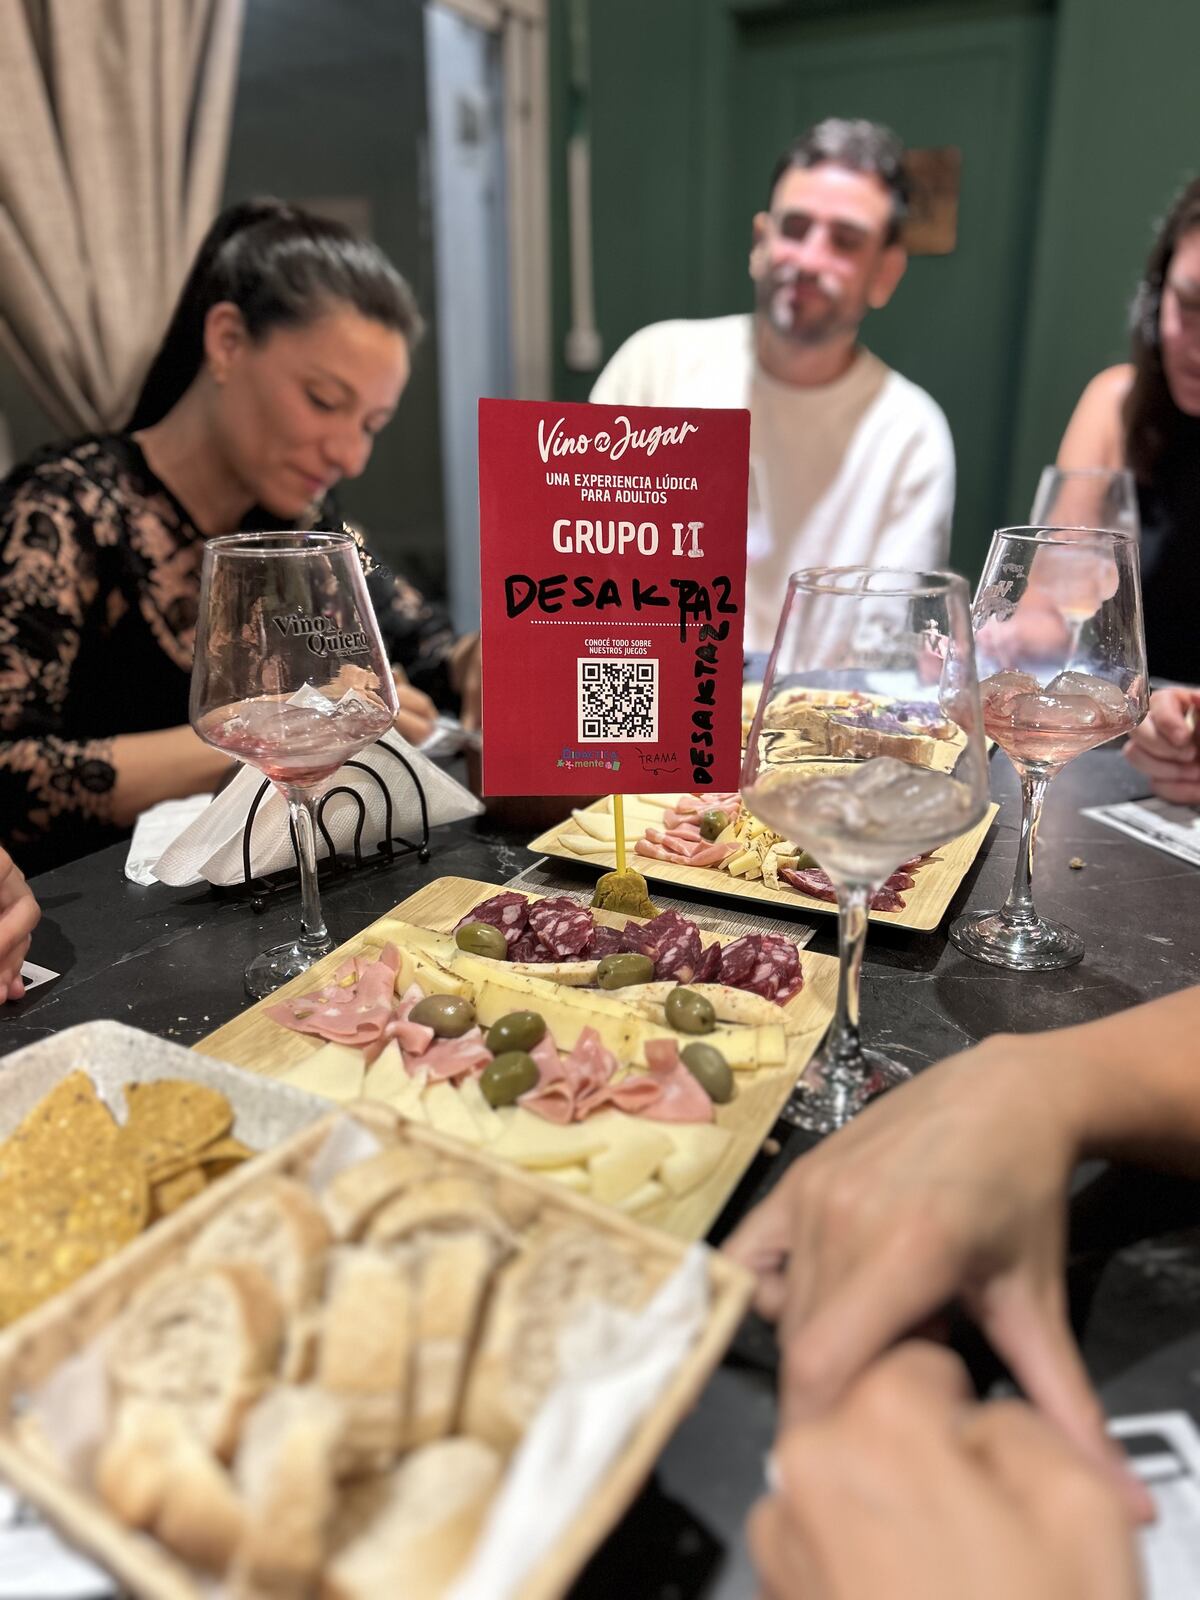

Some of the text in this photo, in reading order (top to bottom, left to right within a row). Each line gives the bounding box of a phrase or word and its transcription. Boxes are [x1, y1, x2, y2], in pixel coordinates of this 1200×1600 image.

[537, 417, 592, 463] Vino
[609, 415, 699, 461] Jugar
[546, 472, 698, 490] UNA EXPERIENCIA LÚDICA
[581, 489, 668, 504] PARA ADULTOS
[552, 519, 659, 556] GRUPO
[272, 614, 326, 637] Vino
[306, 629, 369, 657] Quiero
[584, 637, 652, 647] CONOCÉ TODO SOBRE
[589, 647, 648, 656] NUESTROS JUEGOS
[574, 759, 604, 768] mente
[638, 751, 678, 765] TRAMA
